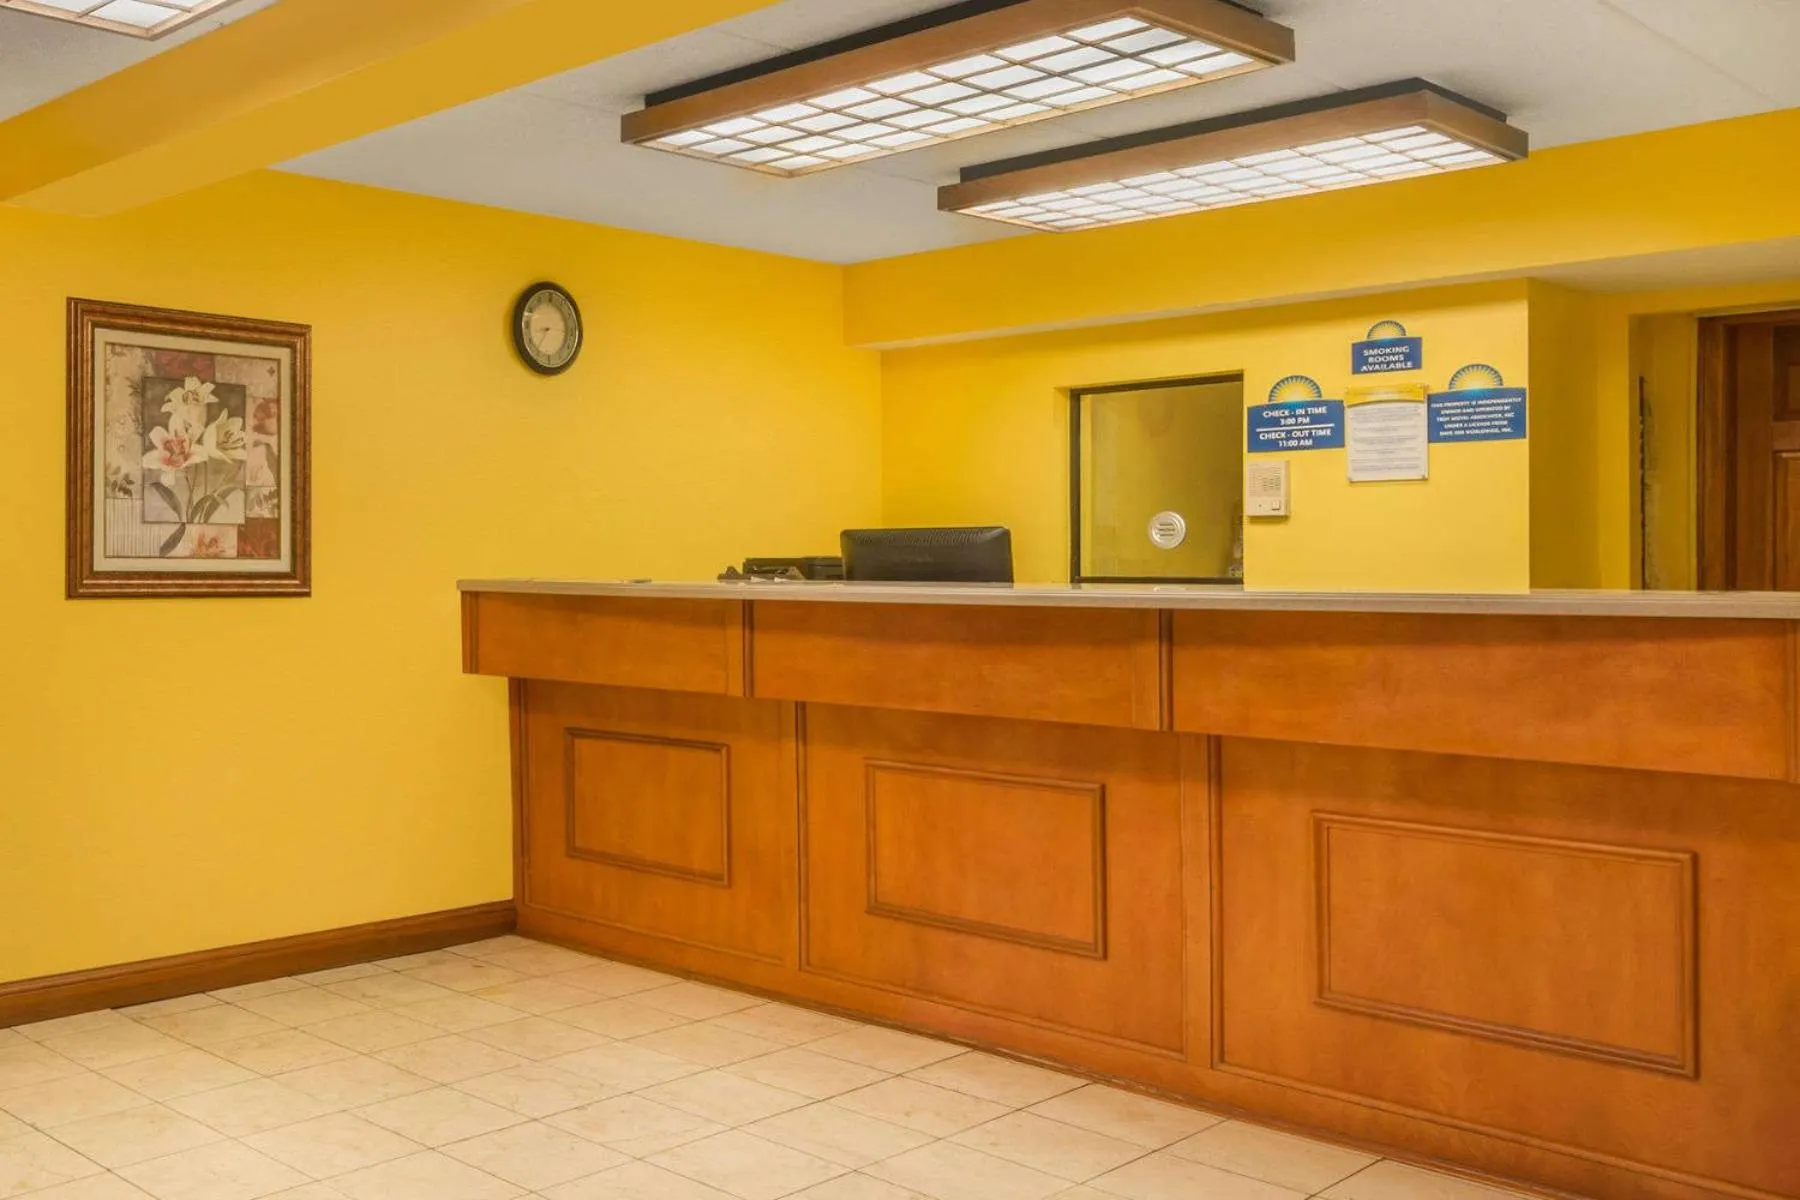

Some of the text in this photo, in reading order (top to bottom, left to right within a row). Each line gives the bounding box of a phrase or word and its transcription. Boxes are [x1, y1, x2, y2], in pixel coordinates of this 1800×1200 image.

[1363, 346, 1410, 356] SMOKING
[1368, 354, 1404, 363] ROOMS
[1361, 361, 1413, 372] AVAILABLE
[1263, 409, 1290, 418] CHECK
[1308, 406, 1327, 415] TIME
[1297, 416, 1310, 424] PM
[1259, 432, 1286, 440] CHECK
[1292, 430, 1309, 438] OUT
[1311, 428, 1332, 436] TIME
